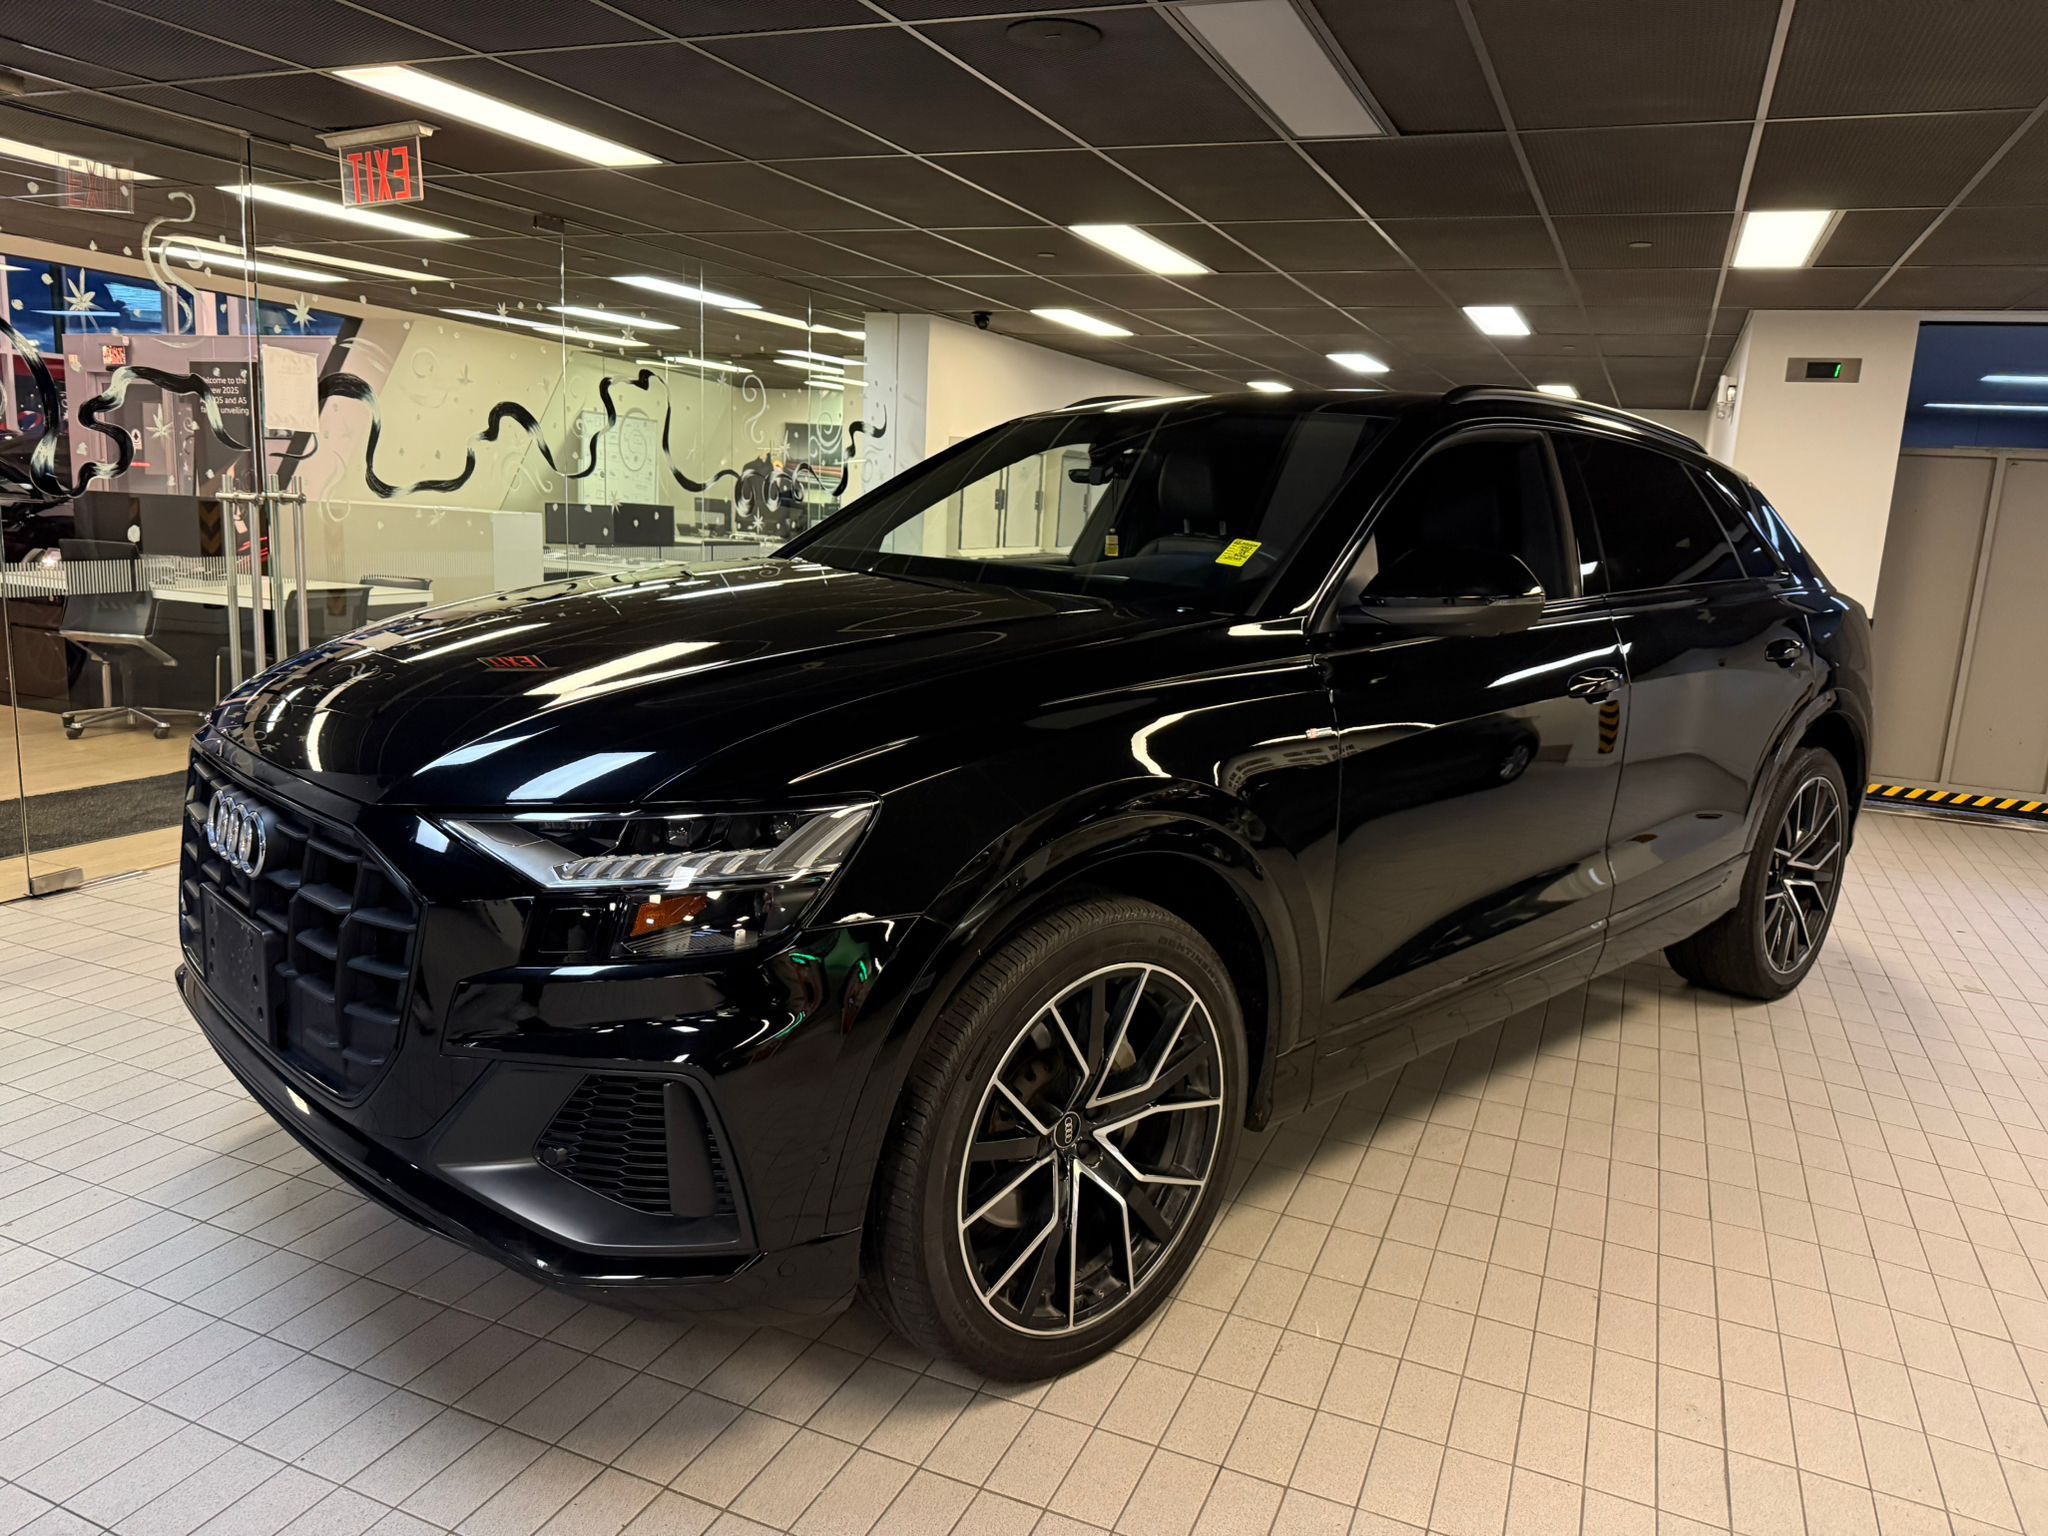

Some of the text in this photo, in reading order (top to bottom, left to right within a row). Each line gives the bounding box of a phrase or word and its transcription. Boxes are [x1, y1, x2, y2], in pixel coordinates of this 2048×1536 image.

[203, 377, 227, 385] elcome
[236, 377, 248, 385] the
[225, 396, 237, 404] and
[220, 407, 250, 416] unveiling
